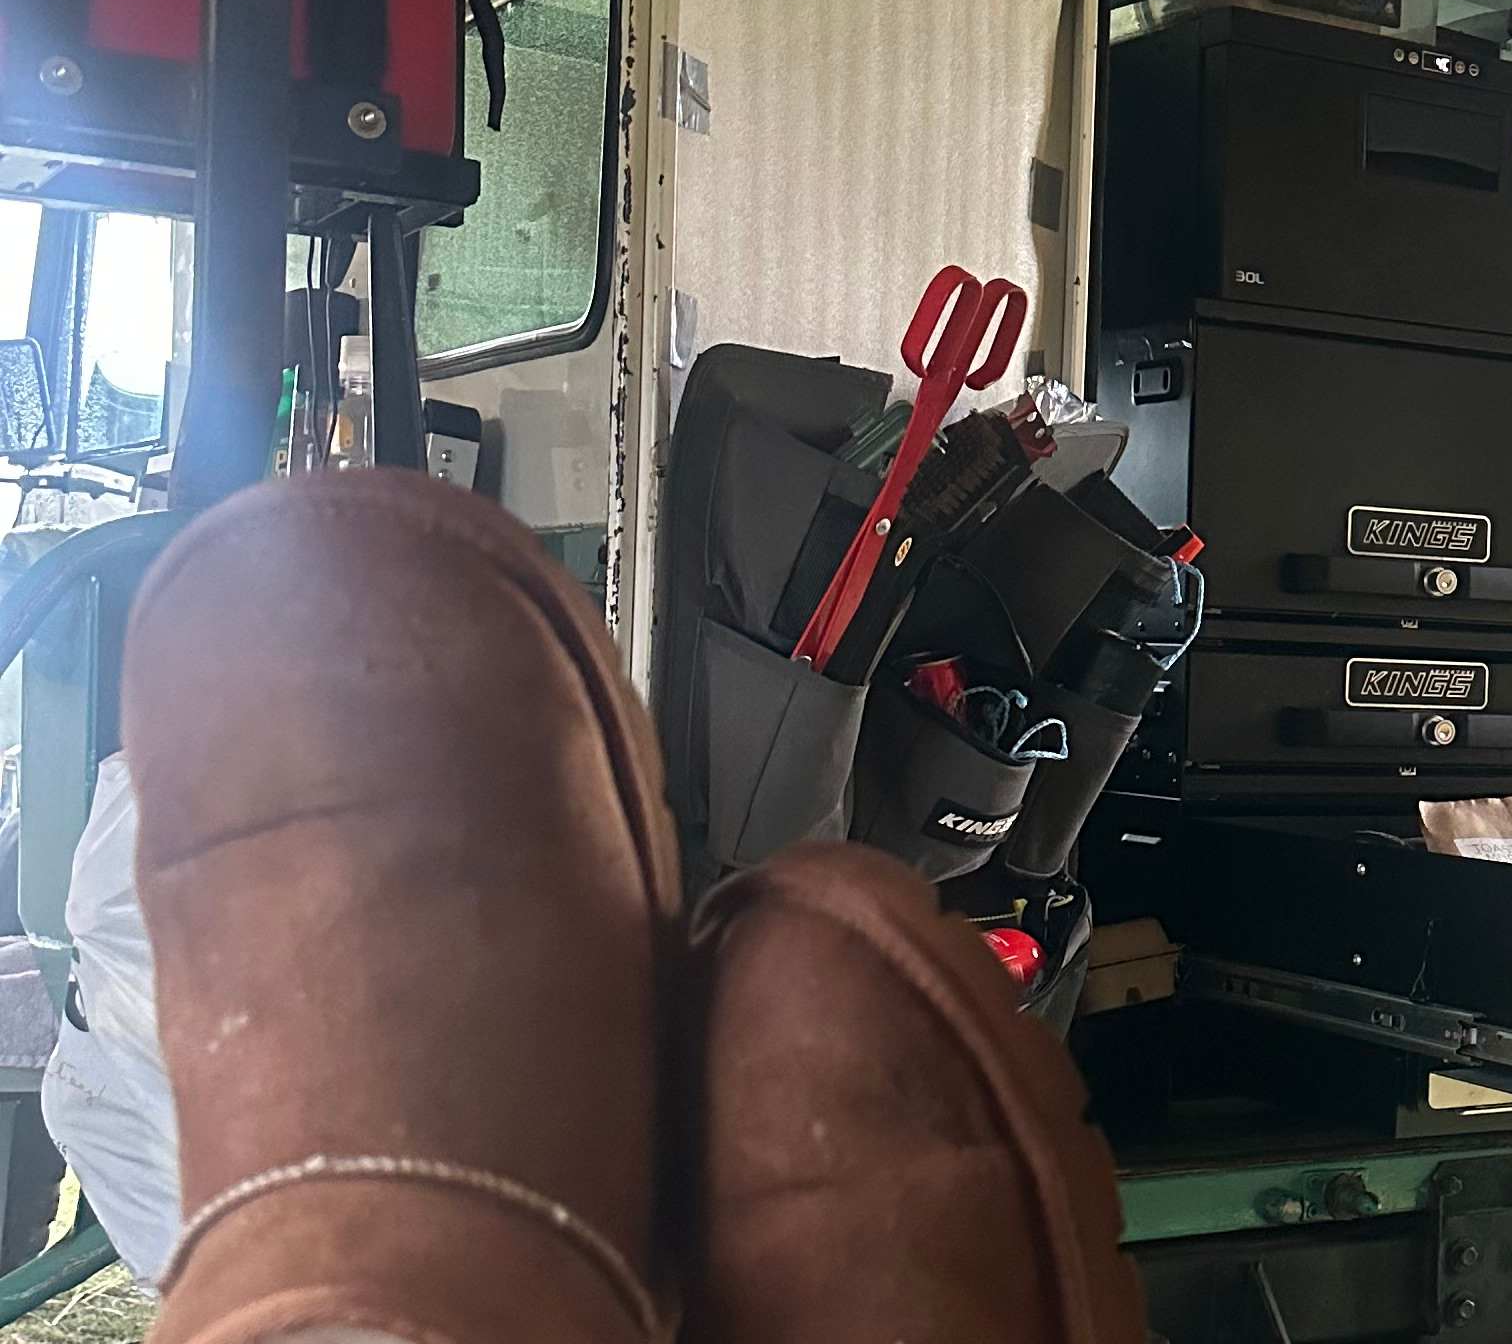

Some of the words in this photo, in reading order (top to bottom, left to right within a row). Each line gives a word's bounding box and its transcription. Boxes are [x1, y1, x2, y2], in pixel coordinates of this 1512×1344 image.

[1235, 270, 1265, 285] 30L
[1363, 519, 1476, 551] KINGS
[1360, 670, 1474, 698] KINGS
